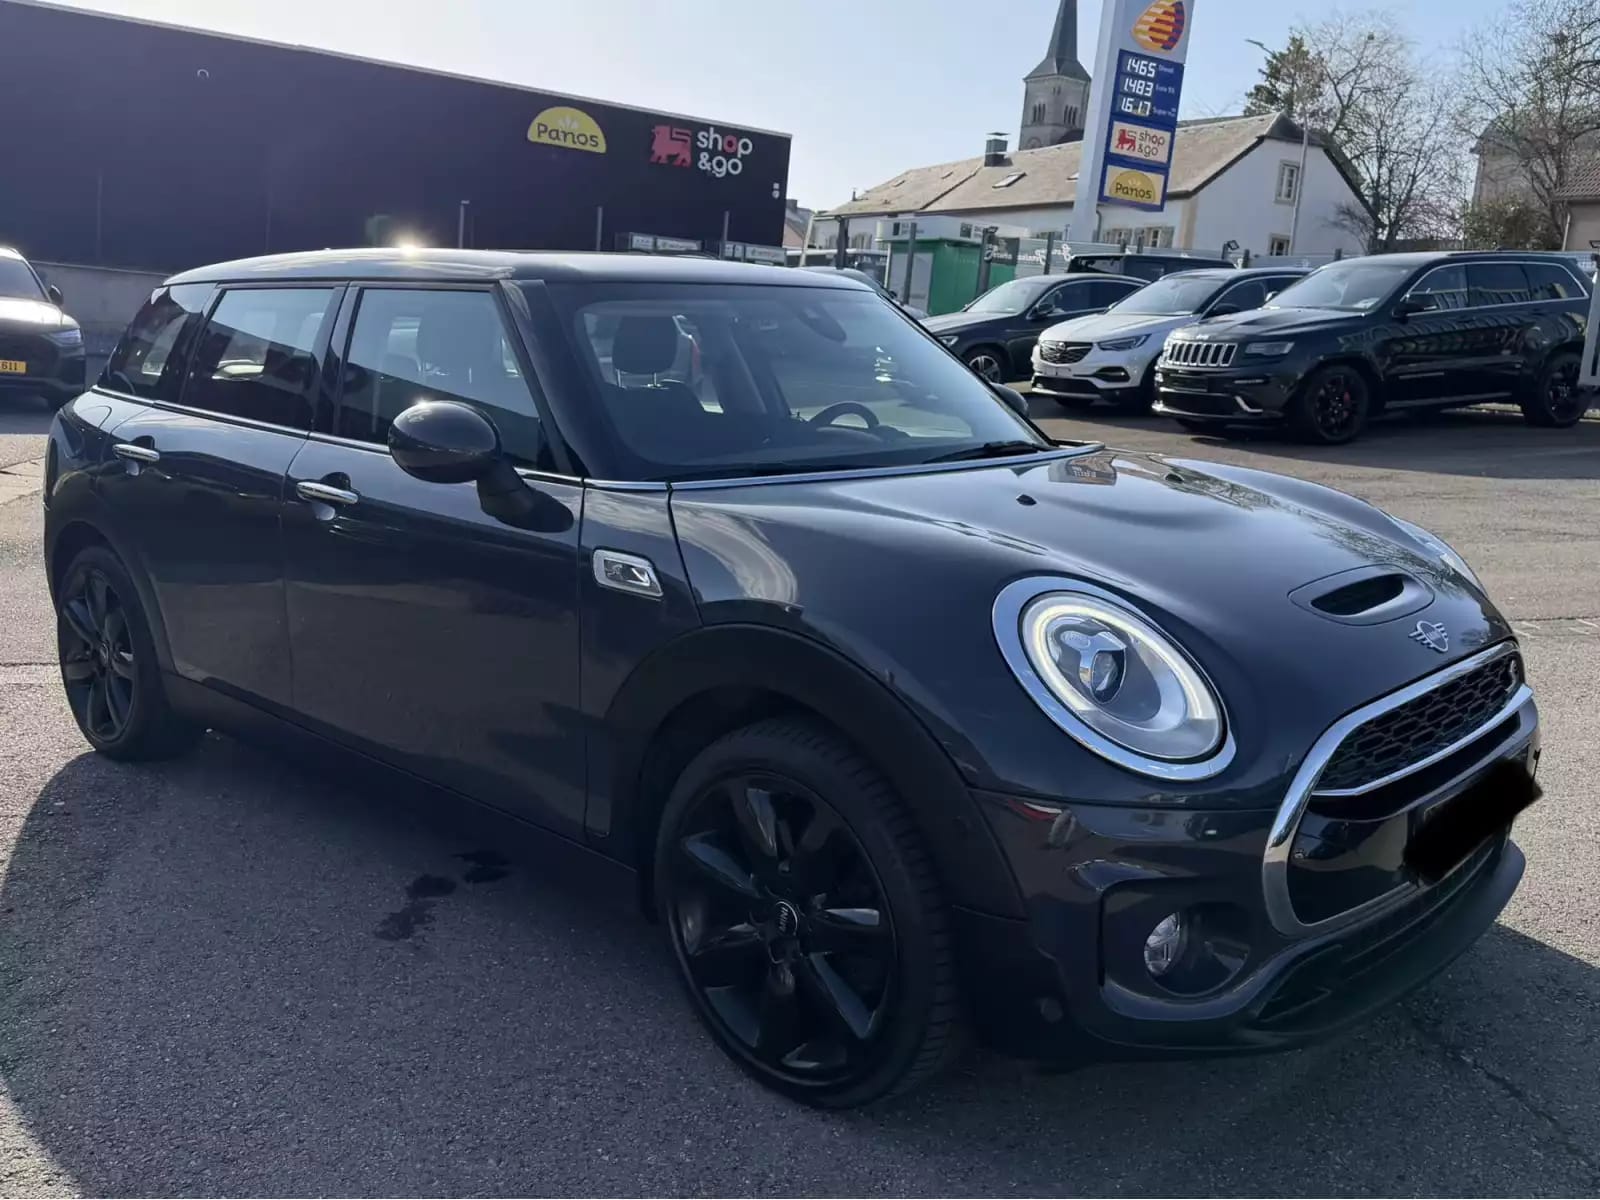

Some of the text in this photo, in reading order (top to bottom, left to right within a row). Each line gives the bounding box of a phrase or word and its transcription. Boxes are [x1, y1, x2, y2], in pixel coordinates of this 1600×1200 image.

[537, 122, 599, 148] Panos
[696, 126, 753, 159] shop
[1139, 130, 1165, 147] shop
[1137, 143, 1159, 158] &go
[697, 151, 743, 178] &go
[1115, 182, 1152, 199] Panos
